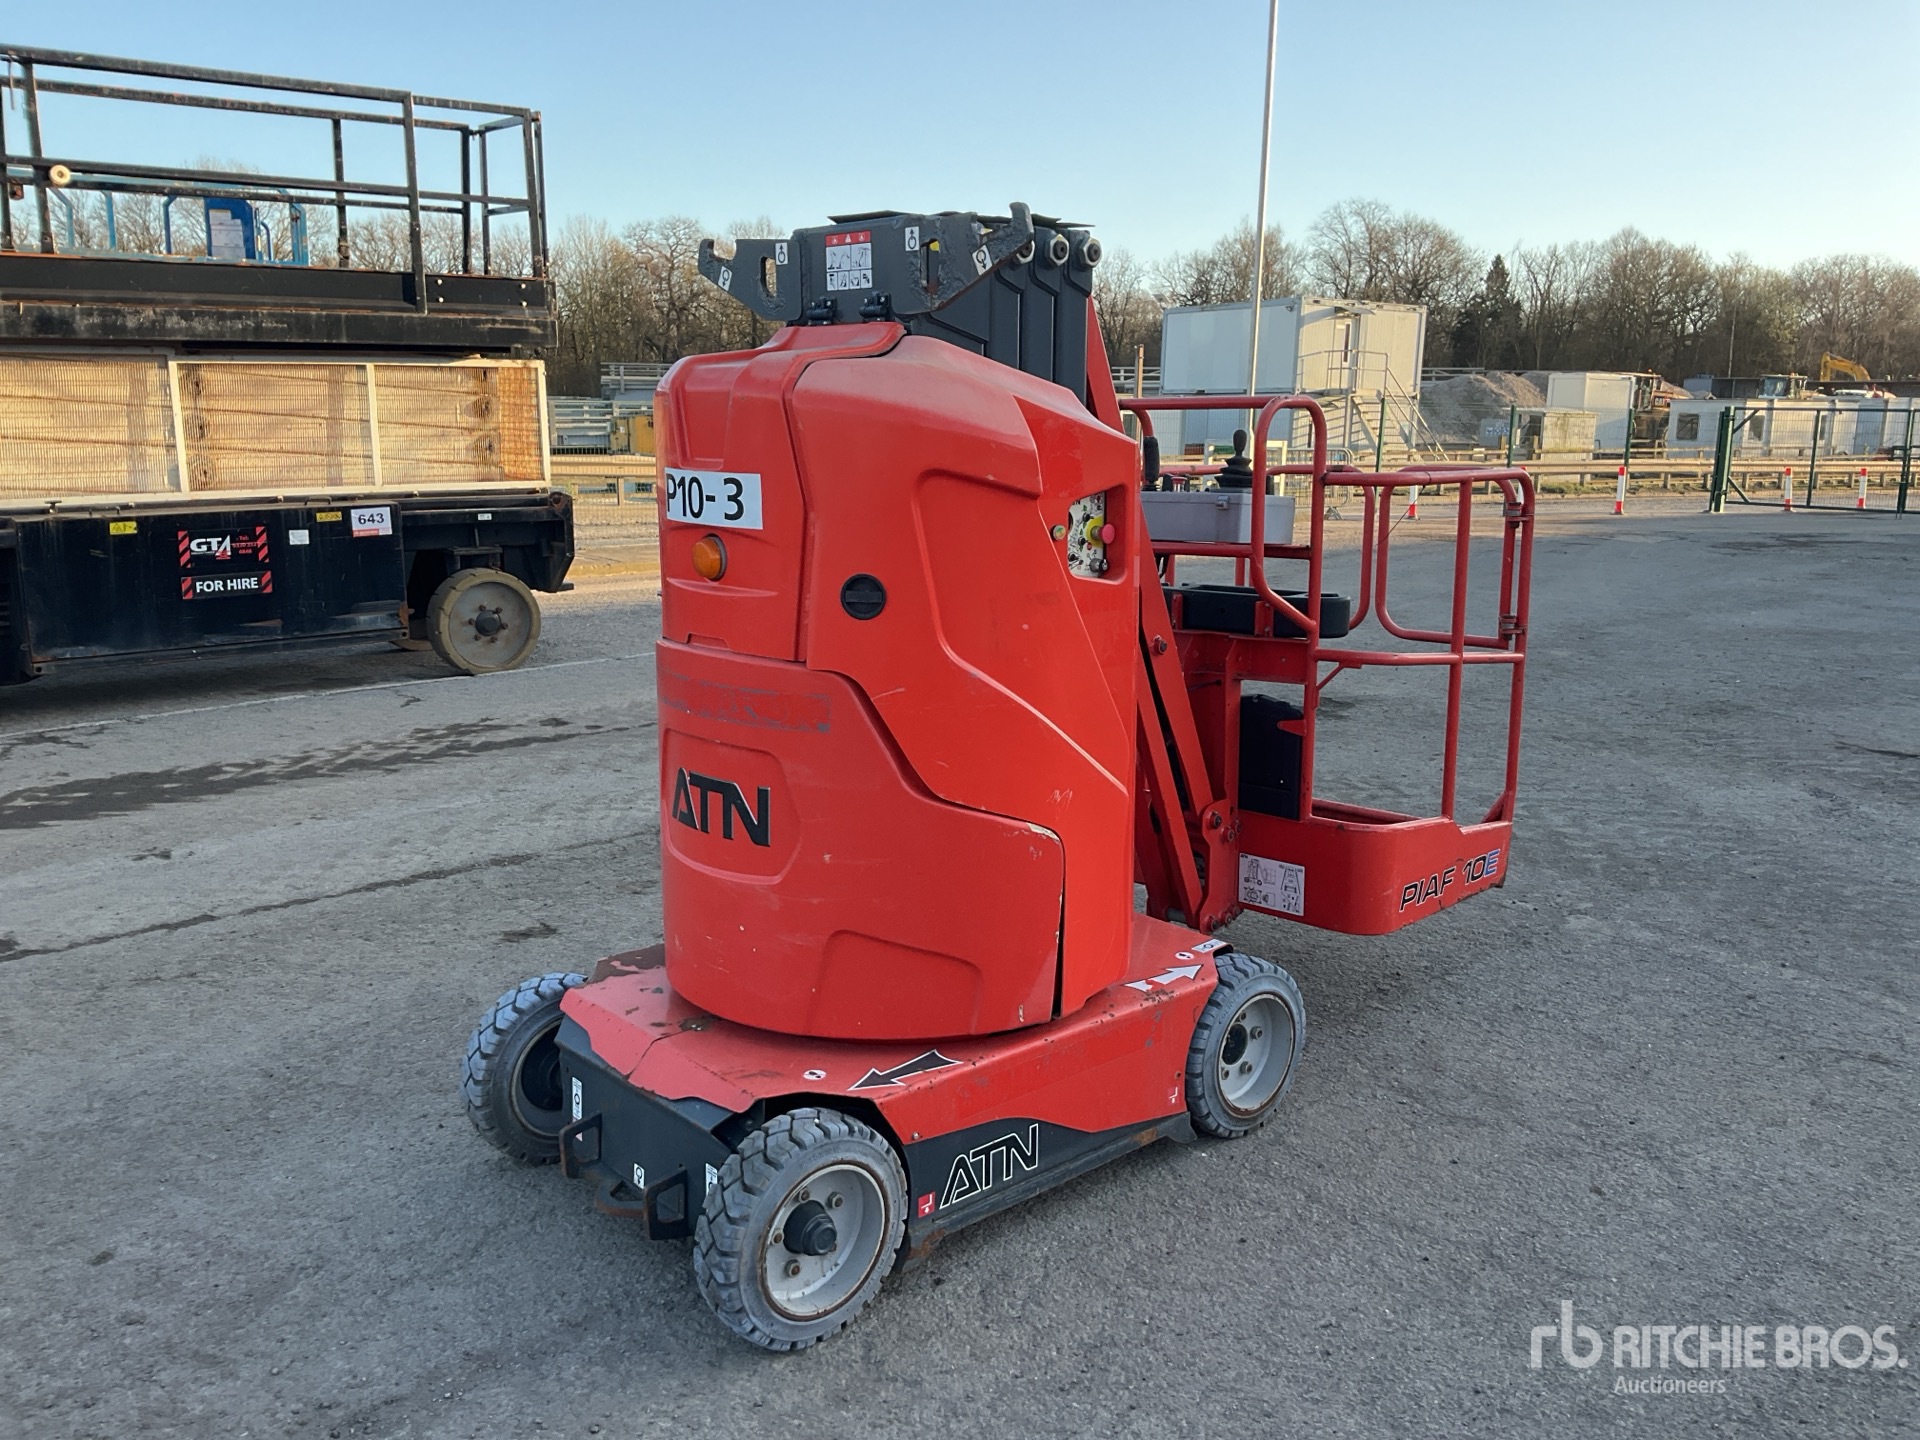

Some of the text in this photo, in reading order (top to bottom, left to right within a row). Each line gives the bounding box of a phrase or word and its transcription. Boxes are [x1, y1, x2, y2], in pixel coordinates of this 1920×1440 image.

[358, 513, 385, 524] 643
[195, 577, 259, 593] FOR HIRE
[672, 767, 770, 847] ATN
[1399, 848, 1501, 913] PIAF 10E
[939, 1123, 1039, 1210] ATN
